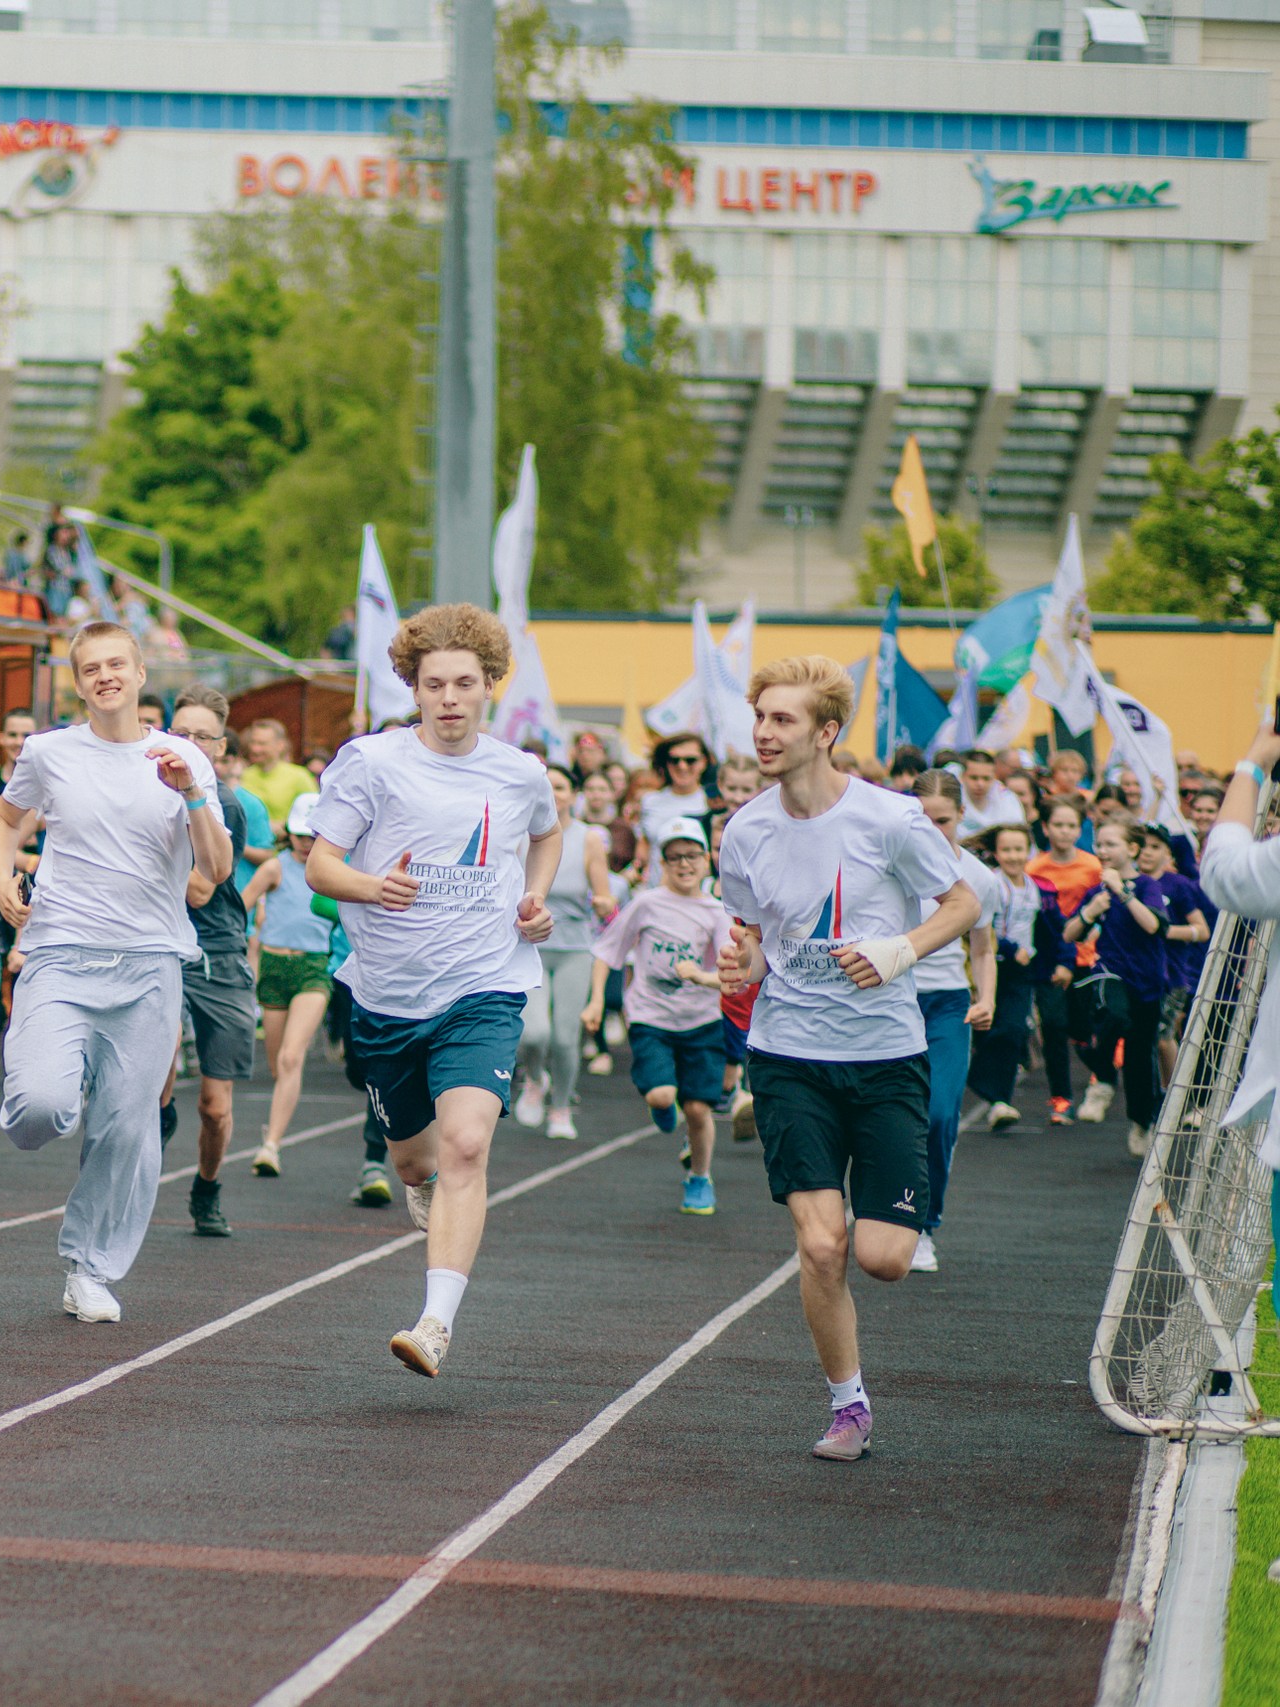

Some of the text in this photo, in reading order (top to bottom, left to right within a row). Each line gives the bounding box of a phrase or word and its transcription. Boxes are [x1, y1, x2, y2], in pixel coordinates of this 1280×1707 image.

[717, 167, 876, 214] ЦЕНТР
[405, 864, 497, 882] ИНАНСОВЫЙ
[365, 1082, 391, 1129] 14
